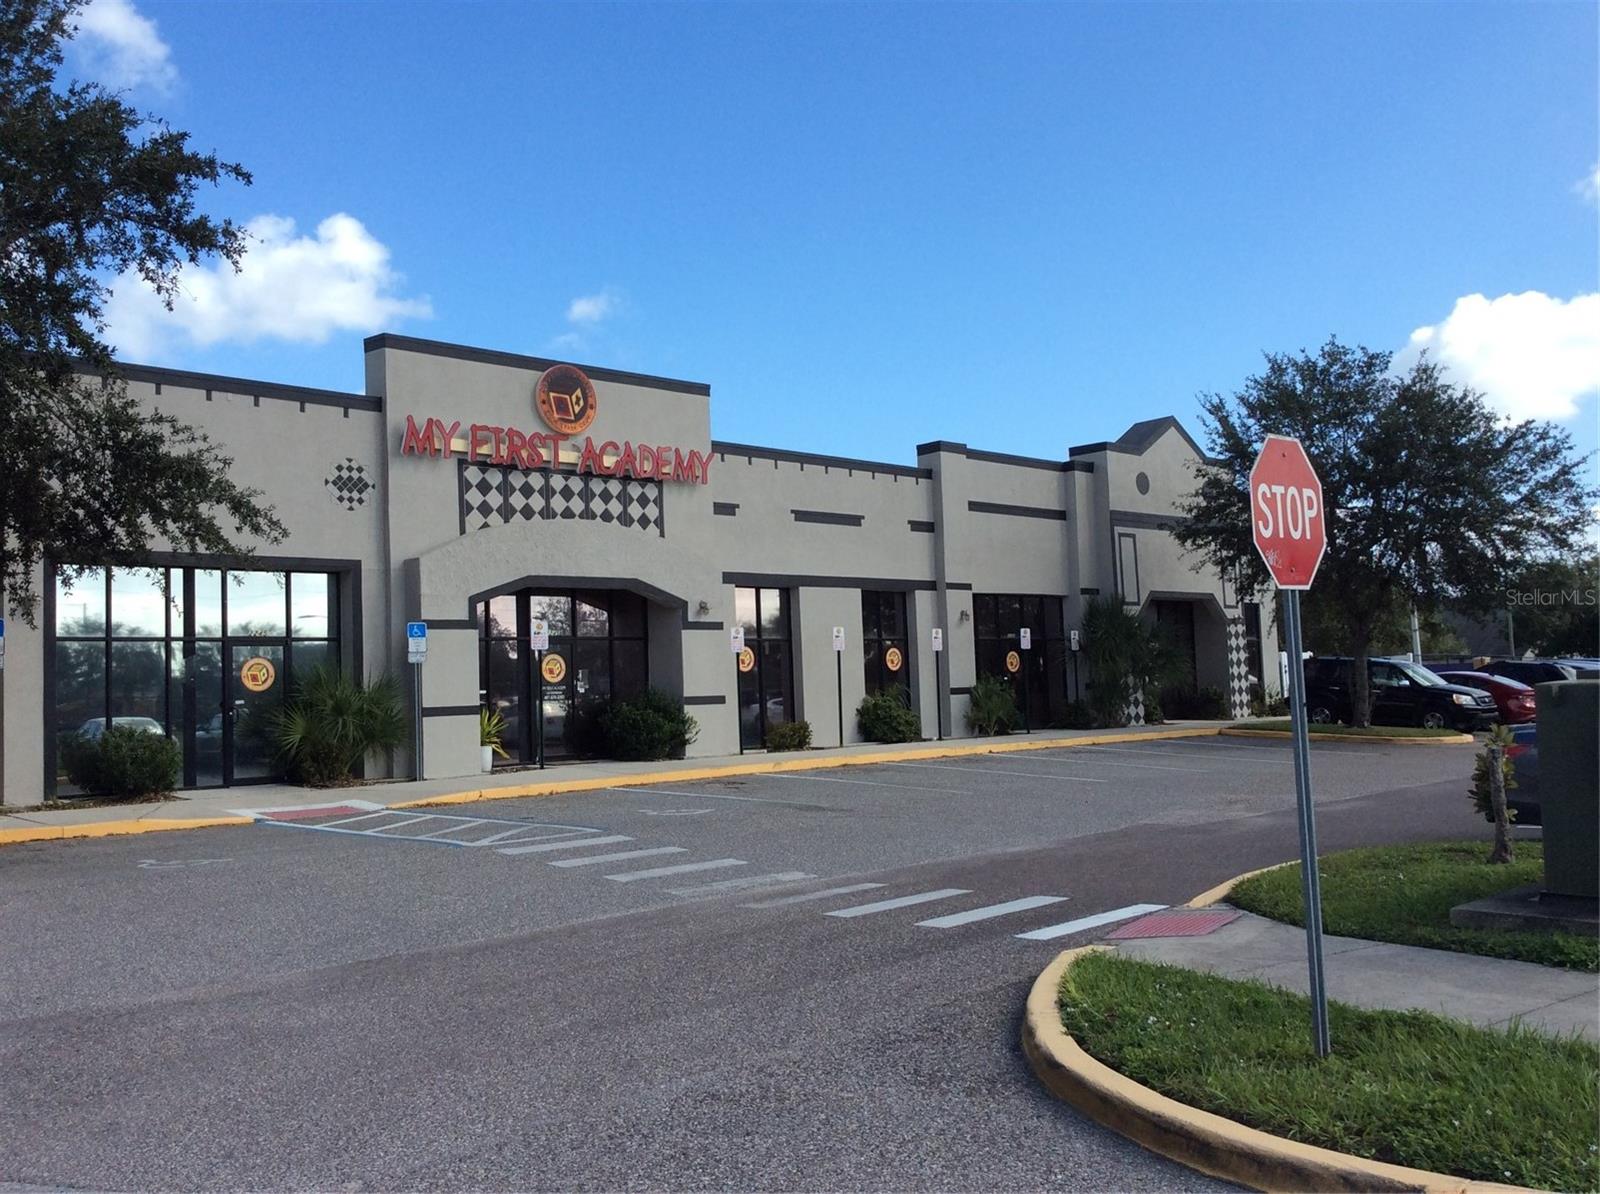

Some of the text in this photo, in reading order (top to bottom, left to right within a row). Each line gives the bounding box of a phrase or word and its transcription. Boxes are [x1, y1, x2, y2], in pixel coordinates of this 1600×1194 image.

[401, 414, 715, 485] MY FIRST ACADEMY
[1257, 483, 1318, 540] STOP
